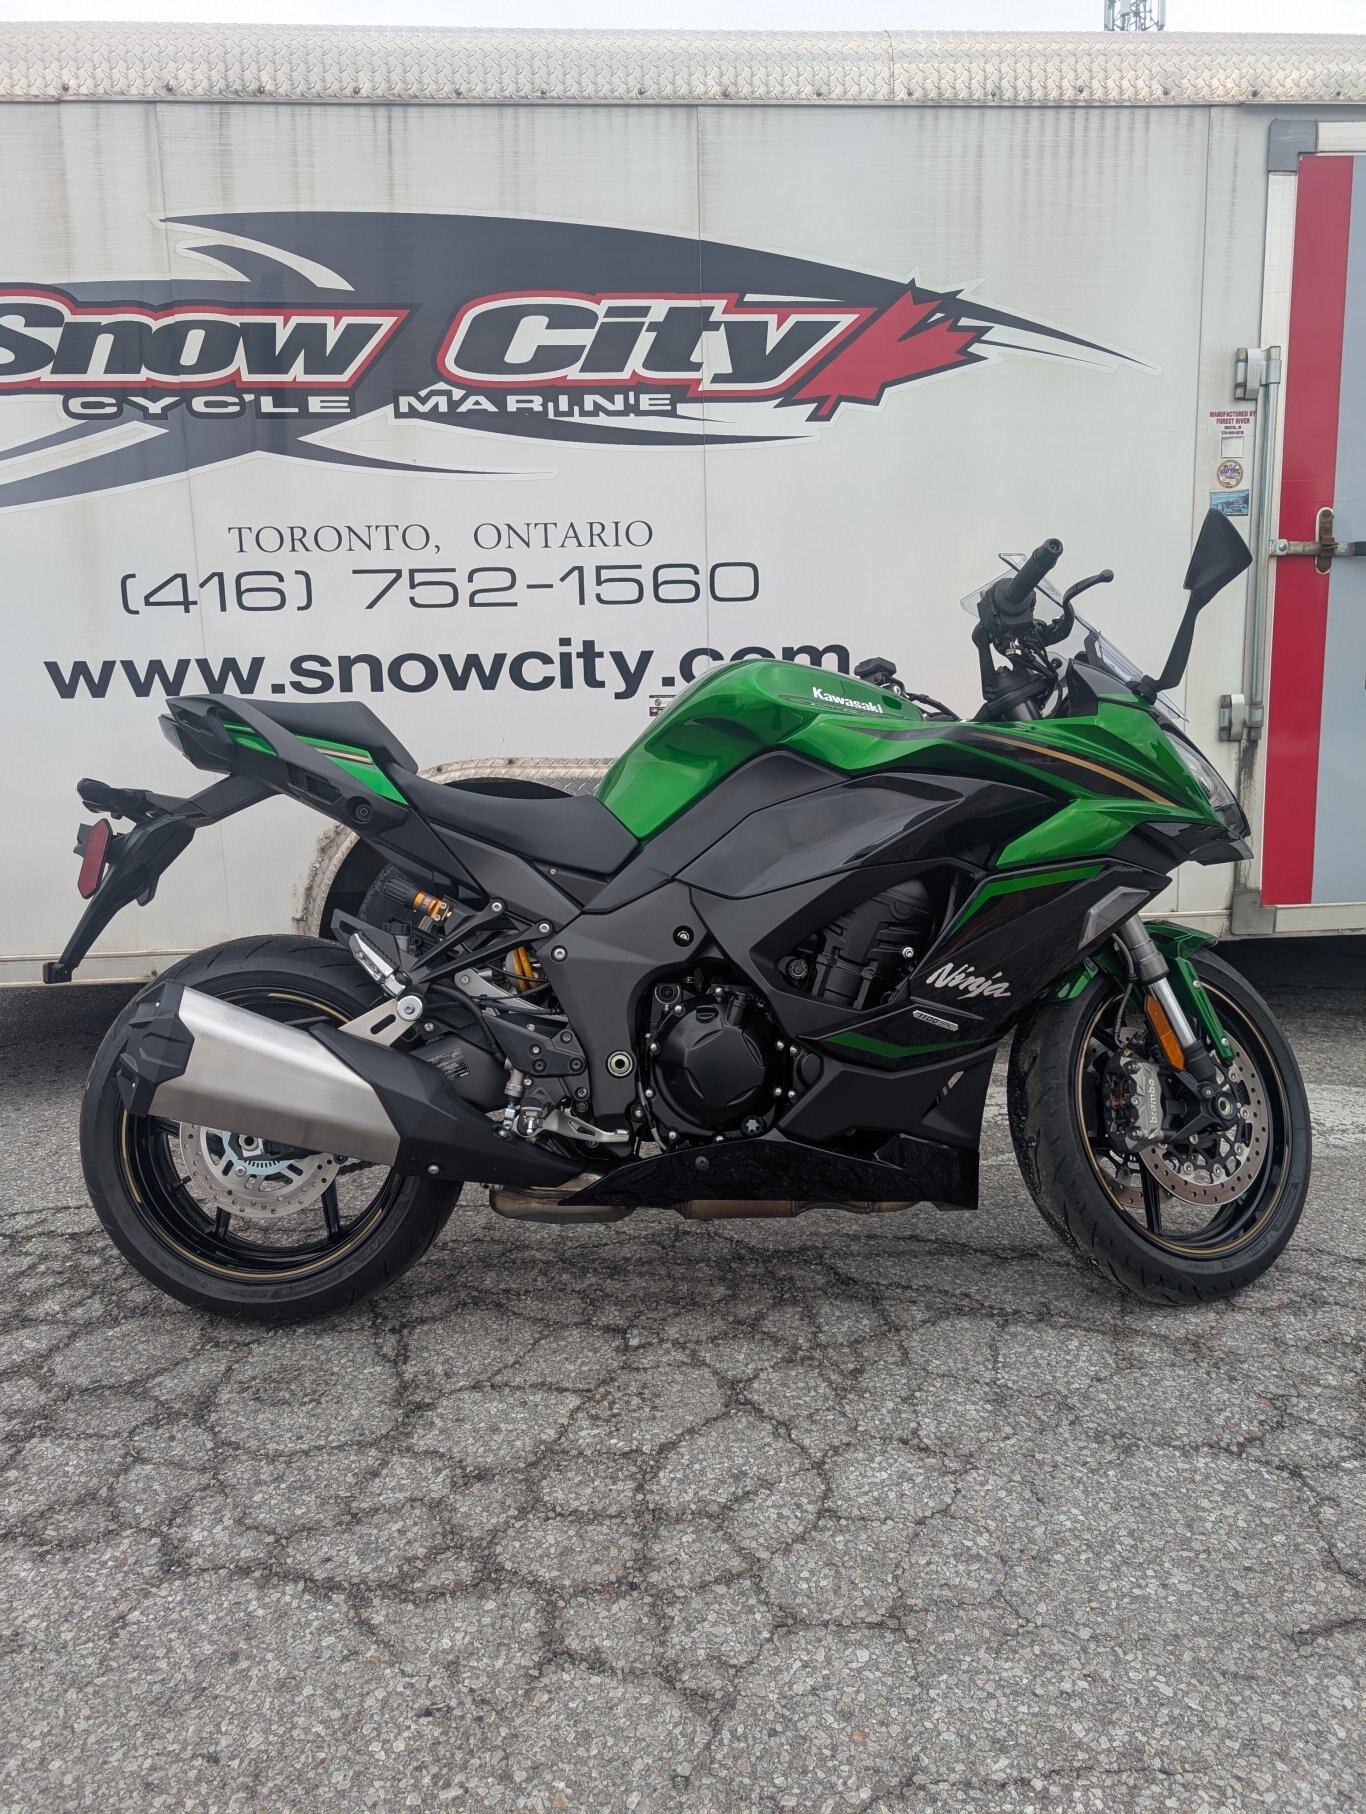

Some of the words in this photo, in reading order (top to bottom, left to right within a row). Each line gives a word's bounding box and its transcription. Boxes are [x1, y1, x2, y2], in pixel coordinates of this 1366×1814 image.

[0, 302, 365, 376] Snow
[453, 303, 844, 384] City
[68, 395, 351, 414] CYCLE
[399, 391, 672, 415] MARINE
[1209, 410, 1249, 418] MANUFACTURED
[1235, 417, 1251, 425] RIVER
[227, 523, 442, 556] TORONTO,
[472, 519, 654, 550] ONTARIO
[119, 569, 314, 615] (416)
[351, 561, 760, 610] 752-1560
[812, 686, 884, 714] Kawasaki
[925, 962, 1012, 1000] Ninja
[1148, 1079, 1158, 1124] brembo
